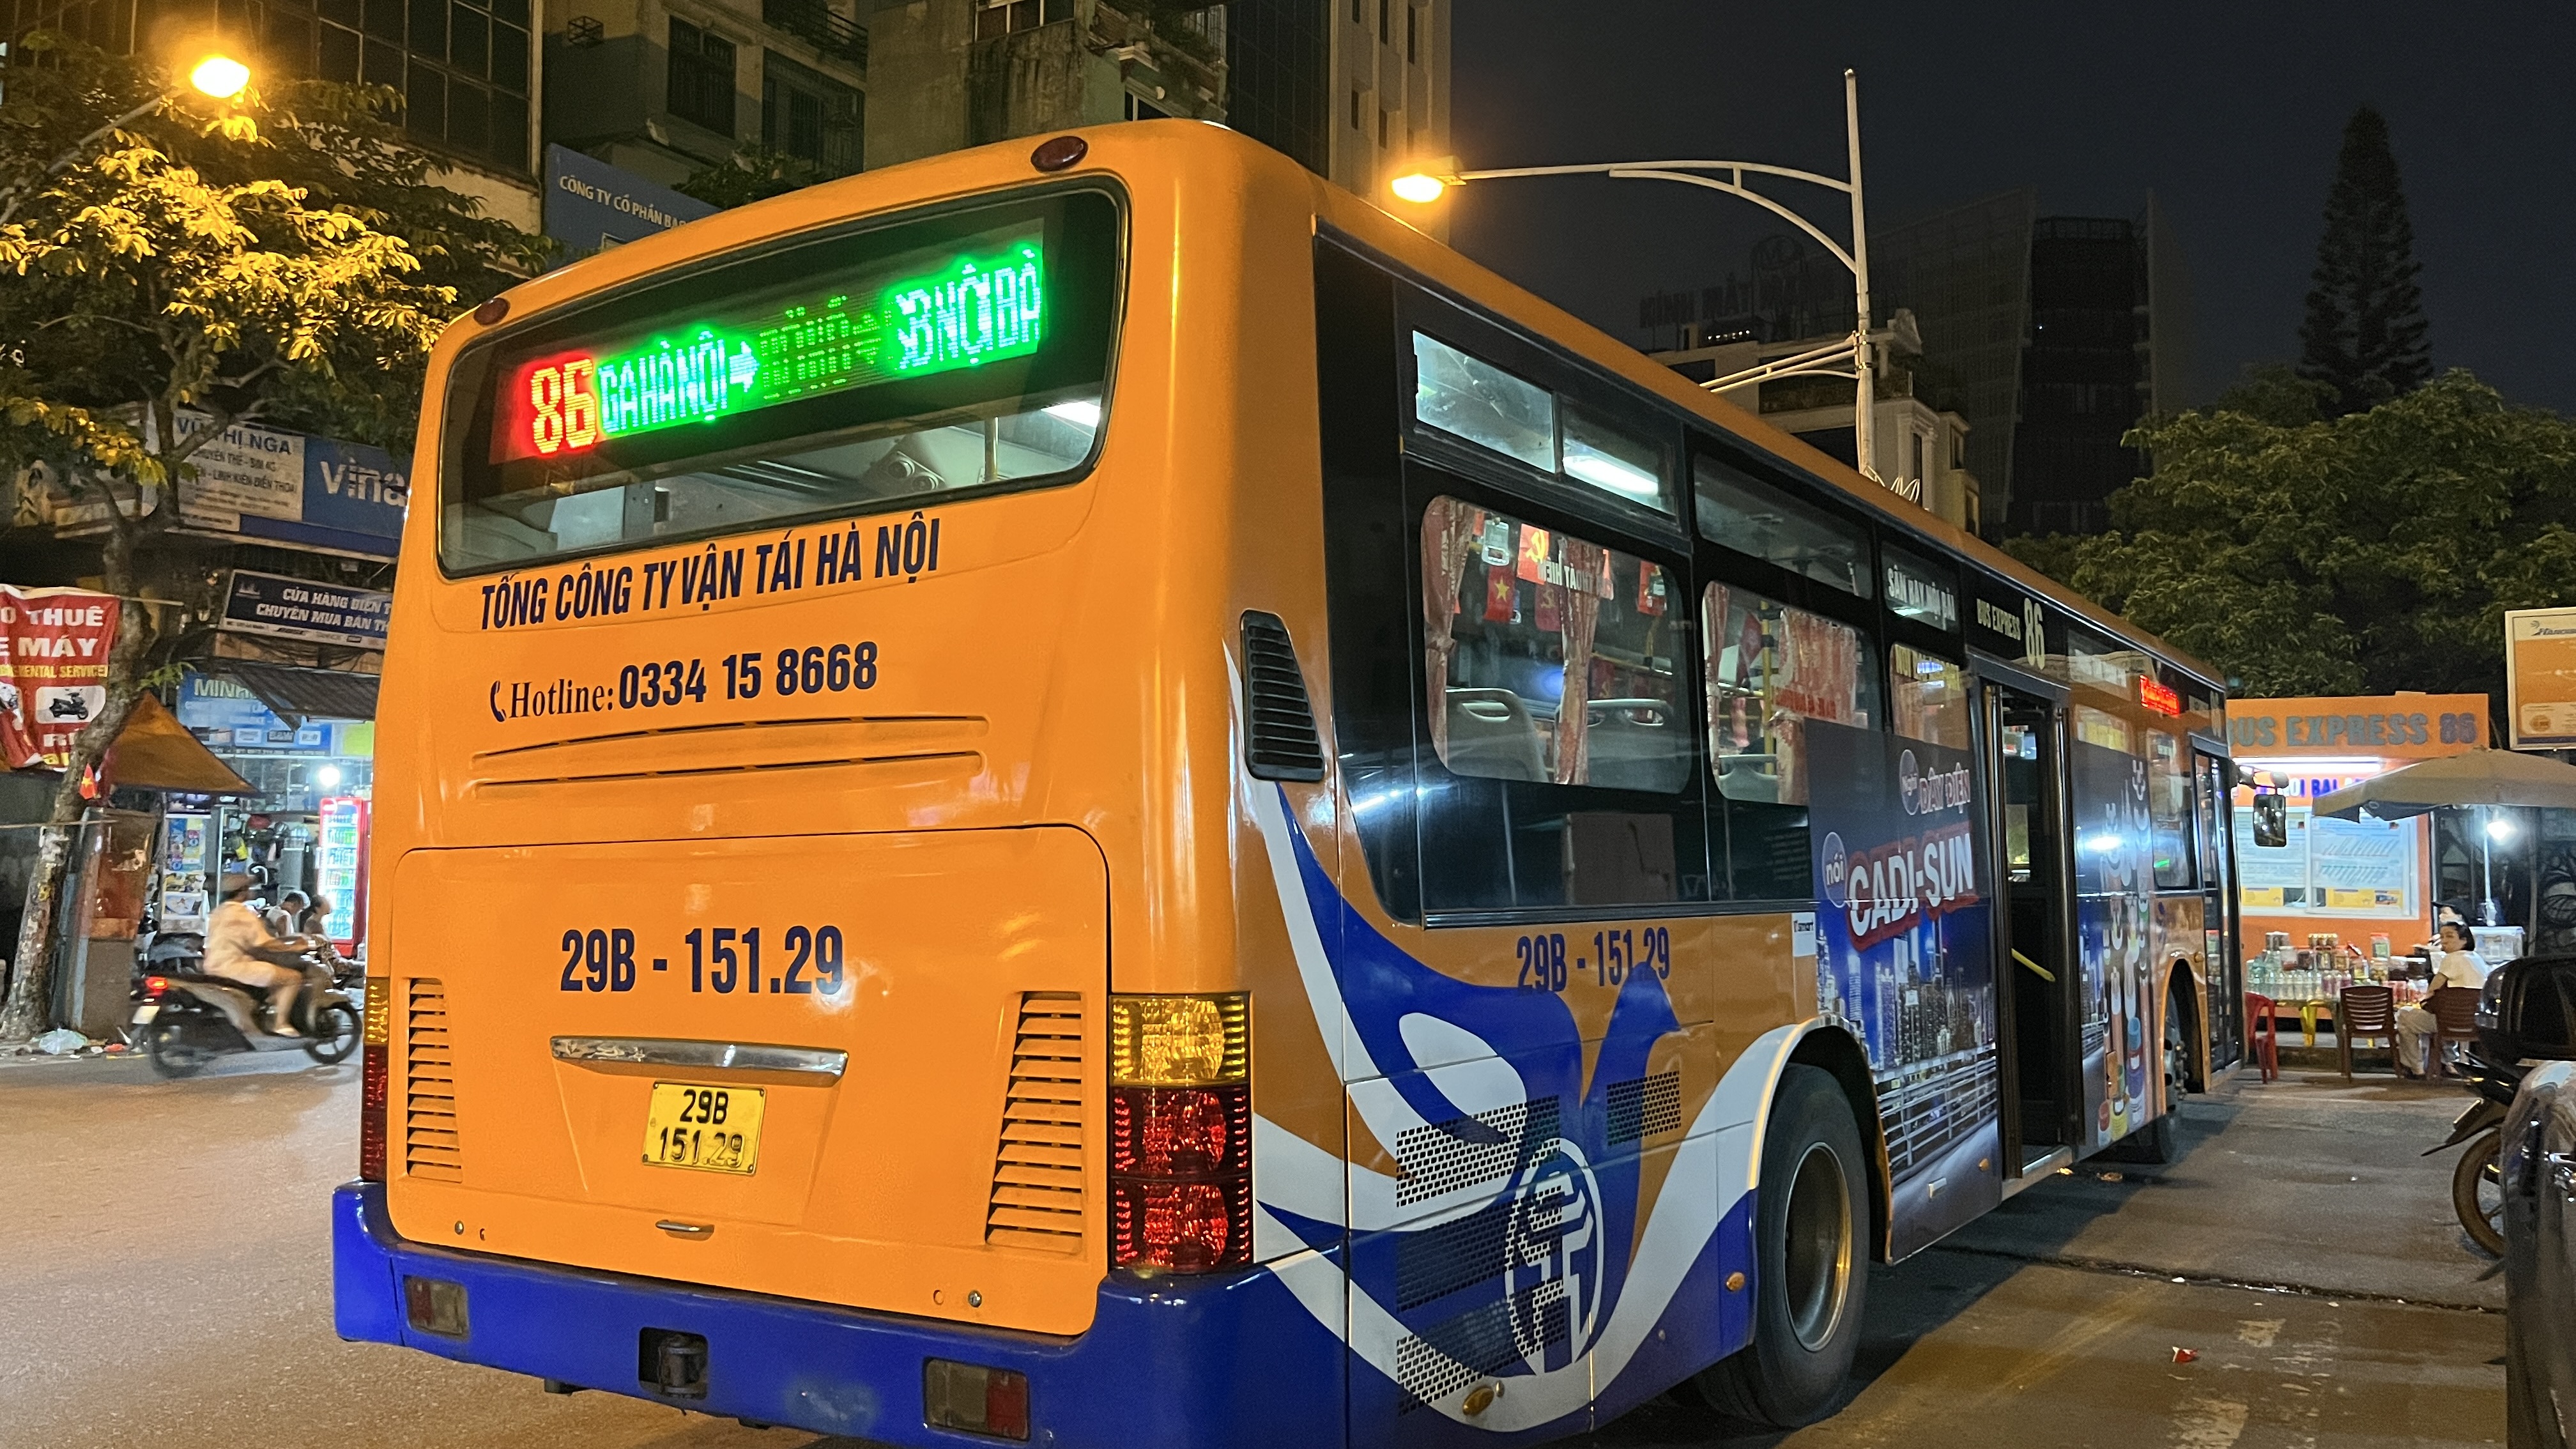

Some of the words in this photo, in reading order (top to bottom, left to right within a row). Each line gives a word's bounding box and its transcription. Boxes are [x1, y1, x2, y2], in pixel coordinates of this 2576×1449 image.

[559, 174, 594, 199] CÔNG
[596, 188, 611, 206] TY
[531, 358, 597, 453] 86
[250, 433, 292, 455] NGA
[555, 562, 632, 621] CÔNG
[642, 560, 677, 611] TY
[681, 543, 746, 611] VẬN
[815, 522, 861, 586] HÀ
[874, 510, 940, 584] NỘI
[26, 605, 103, 626] THUÊ
[256, 603, 310, 622] CHUYÊN
[310, 610, 342, 626] MUA
[343, 614, 371, 630] BÁN
[282, 586, 309, 602] CỬA
[310, 592, 349, 609] HÀNG
[18, 634, 98, 657] MÁY
[2024, 597, 2045, 671] 86
[510, 678, 614, 719] Hotline:
[619, 659, 706, 709] 0334
[723, 652, 762, 700] 15
[776, 641, 878, 696] 8668
[2285, 713, 2428, 746] EXPRESS
[2439, 712, 2477, 745] 86
[1825, 853, 1845, 885] nói
[1848, 832, 1974, 937] CADI-SUN
[560, 928, 636, 992] 29B
[685, 925, 843, 994] 151.29
[1517, 933, 1567, 997] 29B
[1594, 926, 1670, 987] 15129
[680, 1089, 730, 1125] 29B
[659, 1126, 744, 1169] 151.29
